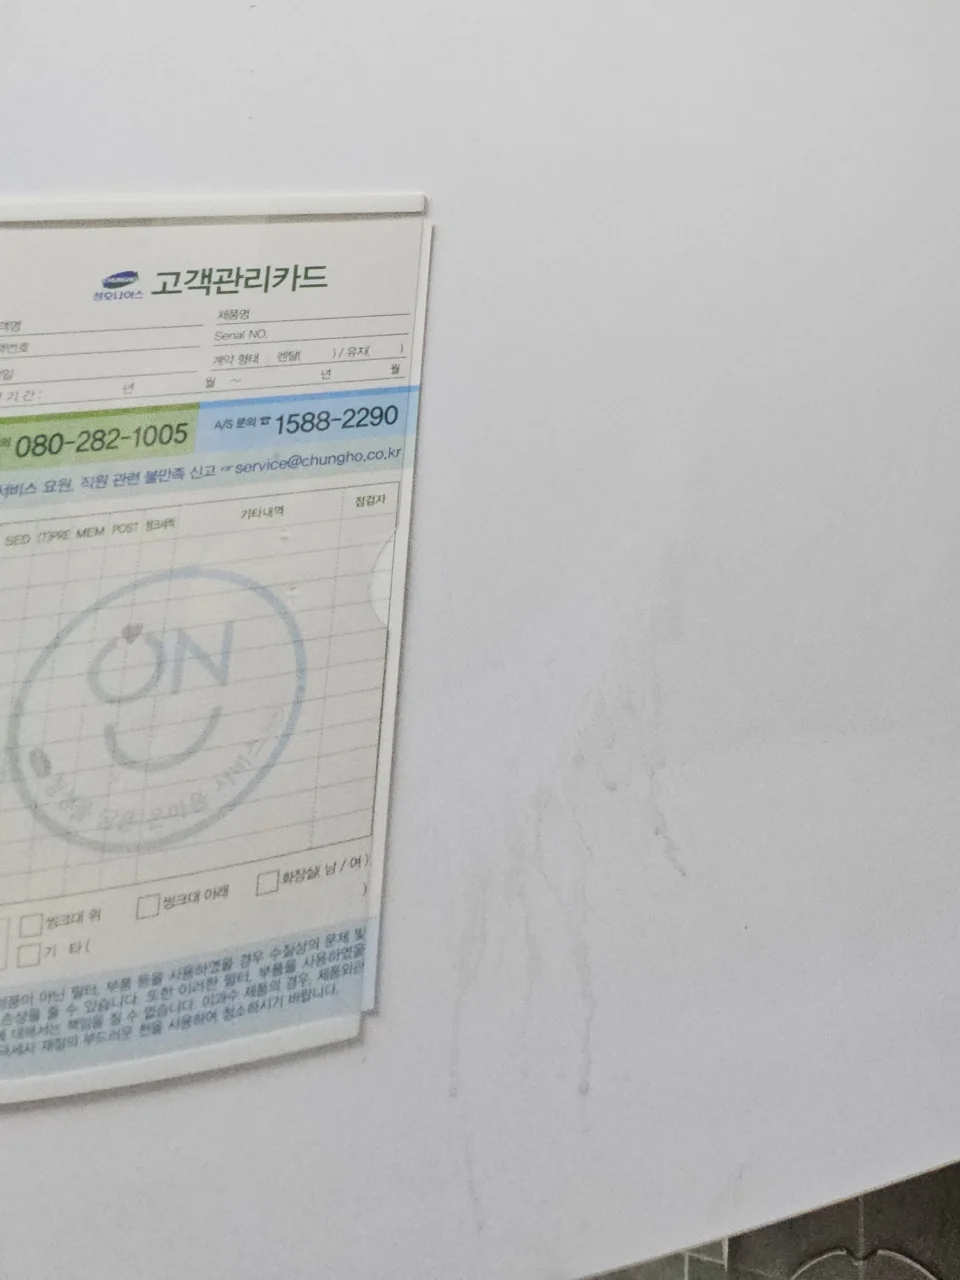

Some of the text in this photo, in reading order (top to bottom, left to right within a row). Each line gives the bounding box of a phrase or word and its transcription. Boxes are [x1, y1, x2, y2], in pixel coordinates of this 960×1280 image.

[151, 264, 328, 296] 고객관리카드
[214, 329, 246, 342] Serial
[213, 417, 233, 431] A/S
[275, 404, 400, 435] 1588-2290
[15, 422, 189, 458] 080-282-1005
[80, 474, 109, 490] 직원
[112, 471, 140, 488] 관련
[144, 467, 186, 485] 불만족
[190, 465, 217, 481] 신고
[234, 446, 402, 475] service@chungho.co.kr
[241, 505, 285, 520] 기타내역
[355, 494, 387, 509] 점검자
[204, 884, 230, 900] 아래
